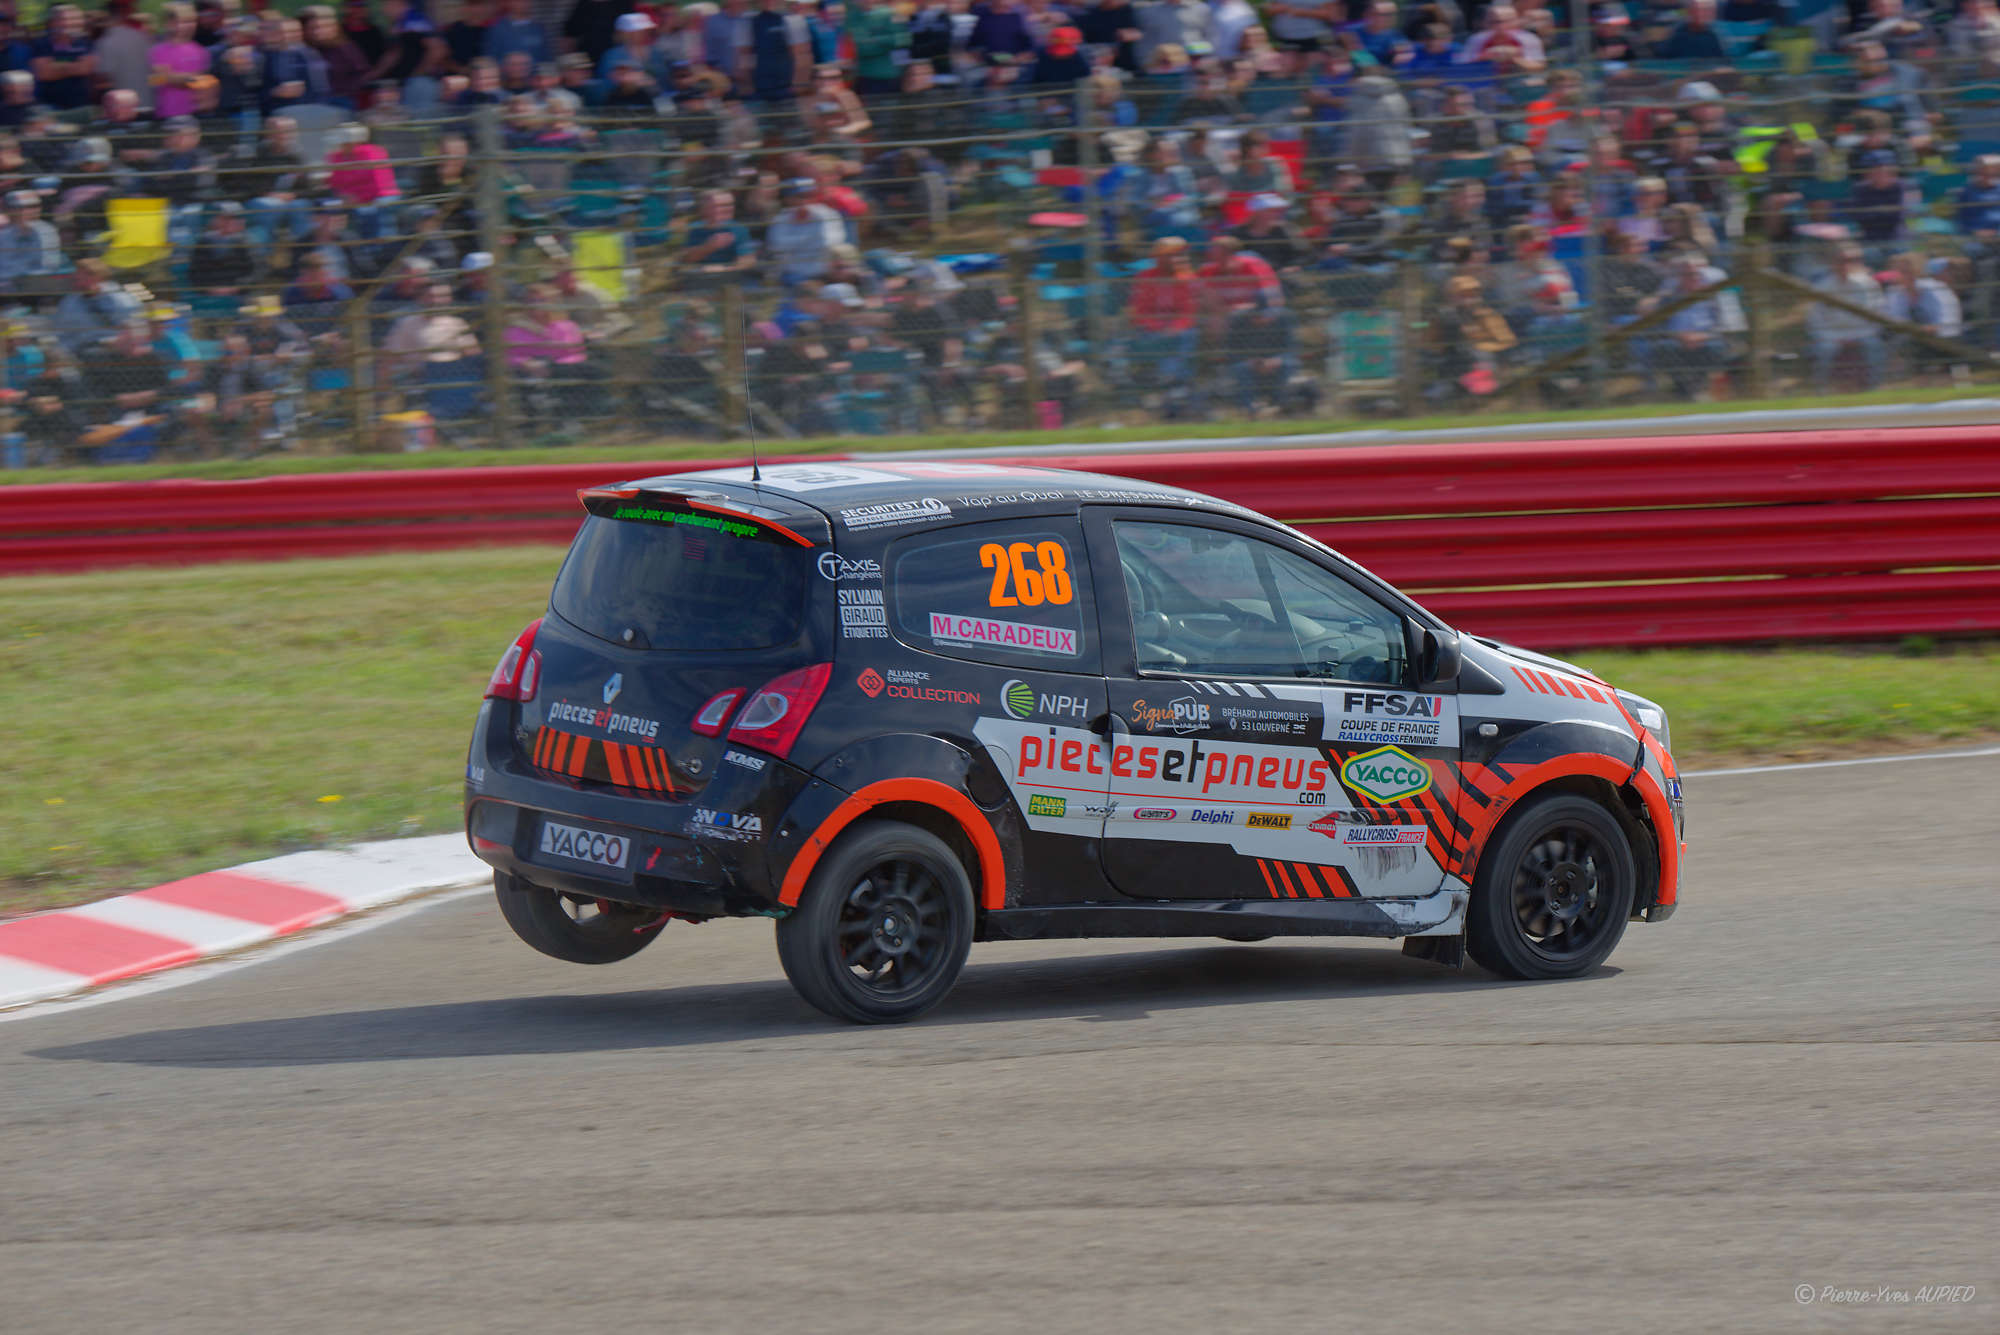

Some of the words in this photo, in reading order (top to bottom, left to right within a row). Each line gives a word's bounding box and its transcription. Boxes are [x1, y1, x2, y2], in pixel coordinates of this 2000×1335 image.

[995, 494, 1018, 504] au
[1020, 489, 1065, 504] Quai
[840, 501, 920, 518] SECURITEST
[822, 559, 881, 577] TAXIS
[979, 541, 1073, 607] 268
[837, 589, 884, 605] SYLVAIN
[844, 607, 884, 623] GIRAUD
[842, 626, 889, 639] ETIQUETTES
[932, 615, 1073, 652] M.CARADEUX
[887, 669, 931, 681] ALLIANCE
[887, 685, 981, 705] COLLECTION
[1038, 693, 1089, 718] NPH
[1343, 692, 1432, 718] FFSA
[1222, 708, 1257, 718] BRÉHARD
[1259, 711, 1310, 722] AUTOMOBILES
[1242, 721, 1250, 731] 53
[1252, 722, 1291, 734] LOUVERNÉ
[1340, 719, 1378, 730] COUPE
[1381, 722, 1396, 732] DE
[1397, 722, 1440, 735] FRANCE
[1354, 764, 1422, 786] YACCO
[1032, 796, 1064, 806] MANN
[1030, 805, 1064, 816] FILTER
[1191, 809, 1234, 824] Delphi
[1347, 828, 1398, 842] RALLYCROSS
[1399, 831, 1424, 843] FRANCE
[550, 826, 622, 865] YACCO
